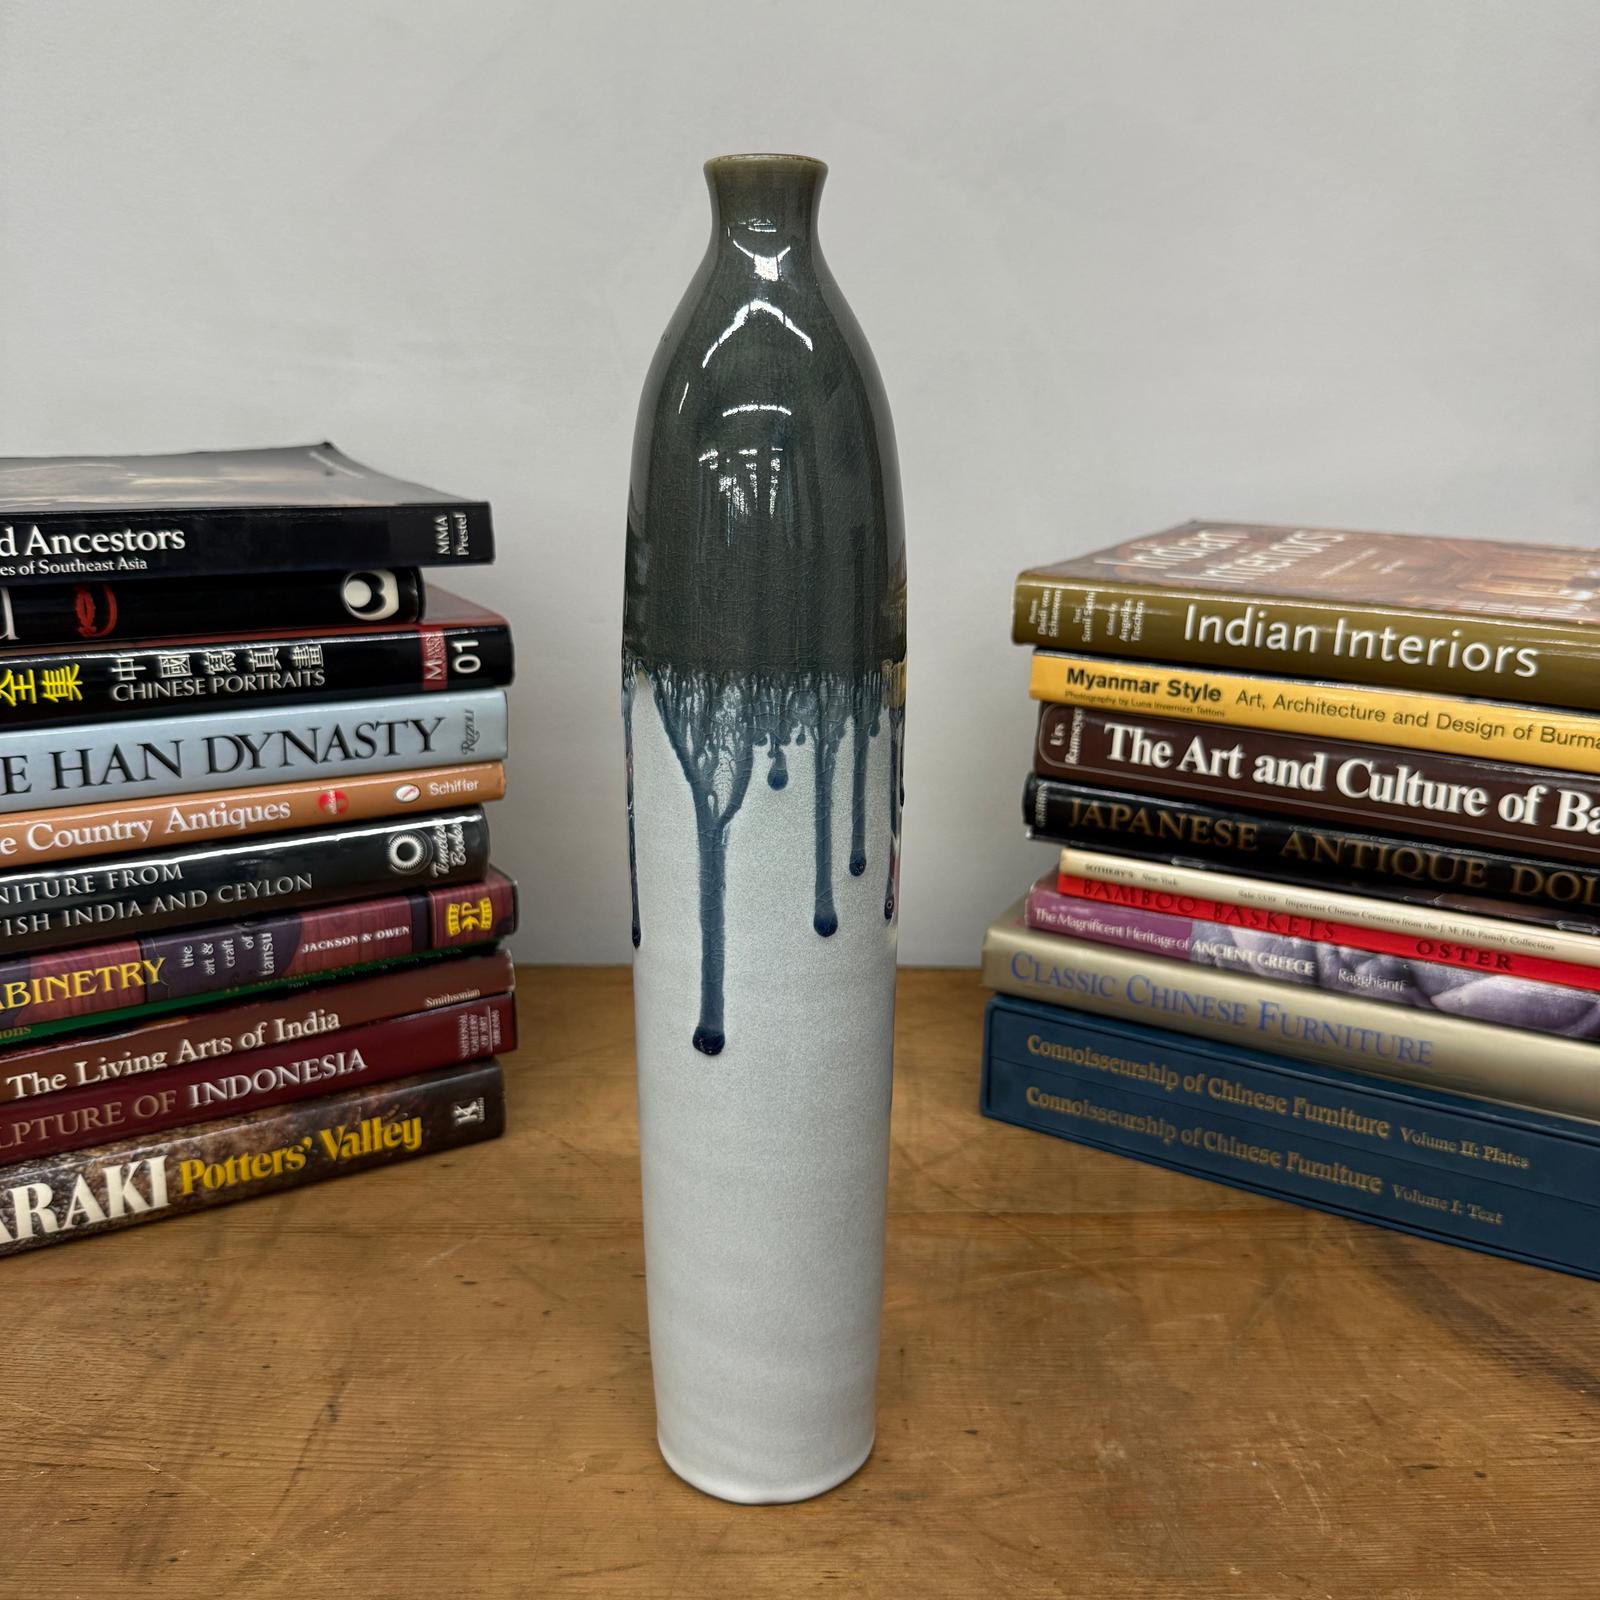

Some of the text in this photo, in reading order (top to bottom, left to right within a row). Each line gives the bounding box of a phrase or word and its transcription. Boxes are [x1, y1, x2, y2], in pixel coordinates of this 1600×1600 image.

[24, 524, 186, 556] Ancestors
[434, 514, 450, 556] MMA
[453, 511, 470, 556] Prestel
[19, 559, 36, 575] of
[38, 558, 115, 574] Southeast
[118, 556, 148, 571] Asia
[451, 639, 482, 674] 01
[1184, 603, 1539, 678] Indian Interiors
[112, 669, 325, 702] CHINESE PORTRAITS
[1067, 667, 1160, 694] Myanmar
[1167, 679, 1222, 704] Style
[1235, 689, 1266, 711] Art,
[1272, 693, 1385, 722] Architecture
[1393, 711, 1429, 728] and
[1436, 713, 1505, 741] Design
[1513, 724, 1535, 741] of
[0, 716, 446, 796] E HAN DYNASTY
[1103, 722, 1173, 769] The
[1176, 735, 1245, 780] Art
[1252, 752, 1328, 791] and
[1336, 758, 1489, 818] Culture
[1498, 784, 1548, 826] of
[429, 779, 479, 797] Schiffer
[0, 836, 17, 855] e
[27, 819, 153, 851] Country
[164, 800, 291, 834] Antiques
[448, 823, 466, 867] Books
[1070, 797, 1261, 851] JAPANESE
[1279, 829, 1488, 888] ANTIQUE
[107, 863, 184, 891] FROM
[0, 873, 313, 937] ISH INDIA AND CEYLON
[1084, 880, 1334, 939] BAMBOO BASKETS
[221, 938, 235, 968] craft
[241, 935, 254, 950] of
[258, 933, 275, 976] tansu
[301, 926, 410, 954] JACKSON & OWEN
[1035, 908, 1316, 977] The Magnificent Heritage of ANCIENT GREECE
[1401, 918, 1422, 930] from
[1424, 922, 1439, 931] the
[1510, 935, 1555, 950] Collection
[1416, 940, 1512, 970] OSTER
[181, 945, 194, 968] the
[201, 943, 216, 975] art &
[0, 957, 166, 1013] BINETRY
[425, 989, 480, 1007] Smithsonian
[1338, 968, 1407, 993] Ragghianti
[1011, 951, 1434, 1066] CLASSIC CHINESE FURNITURE
[7, 1008, 340, 1099] The Living Arts of India
[134, 1090, 177, 1118] OF
[189, 1048, 367, 1109] INDONESIA
[1027, 1034, 1179, 1092] Connoisseurship
[1183, 1073, 1205, 1093] of
[1207, 1077, 1289, 1115] Chinese
[1293, 1095, 1391, 1139] Furniture
[1400, 1126, 1456, 1152] Volume
[1482, 1145, 1530, 1169] Plates
[320, 1115, 424, 1162] Valley
[1025, 1086, 1177, 1145] Connoisseurship
[1180, 1127, 1203, 1146] of
[1203, 1130, 1281, 1168] Chinese
[1286, 1151, 1383, 1196] Furniture
[1392, 1183, 1448, 1211] Volume
[1467, 1204, 1503, 1225] Text
